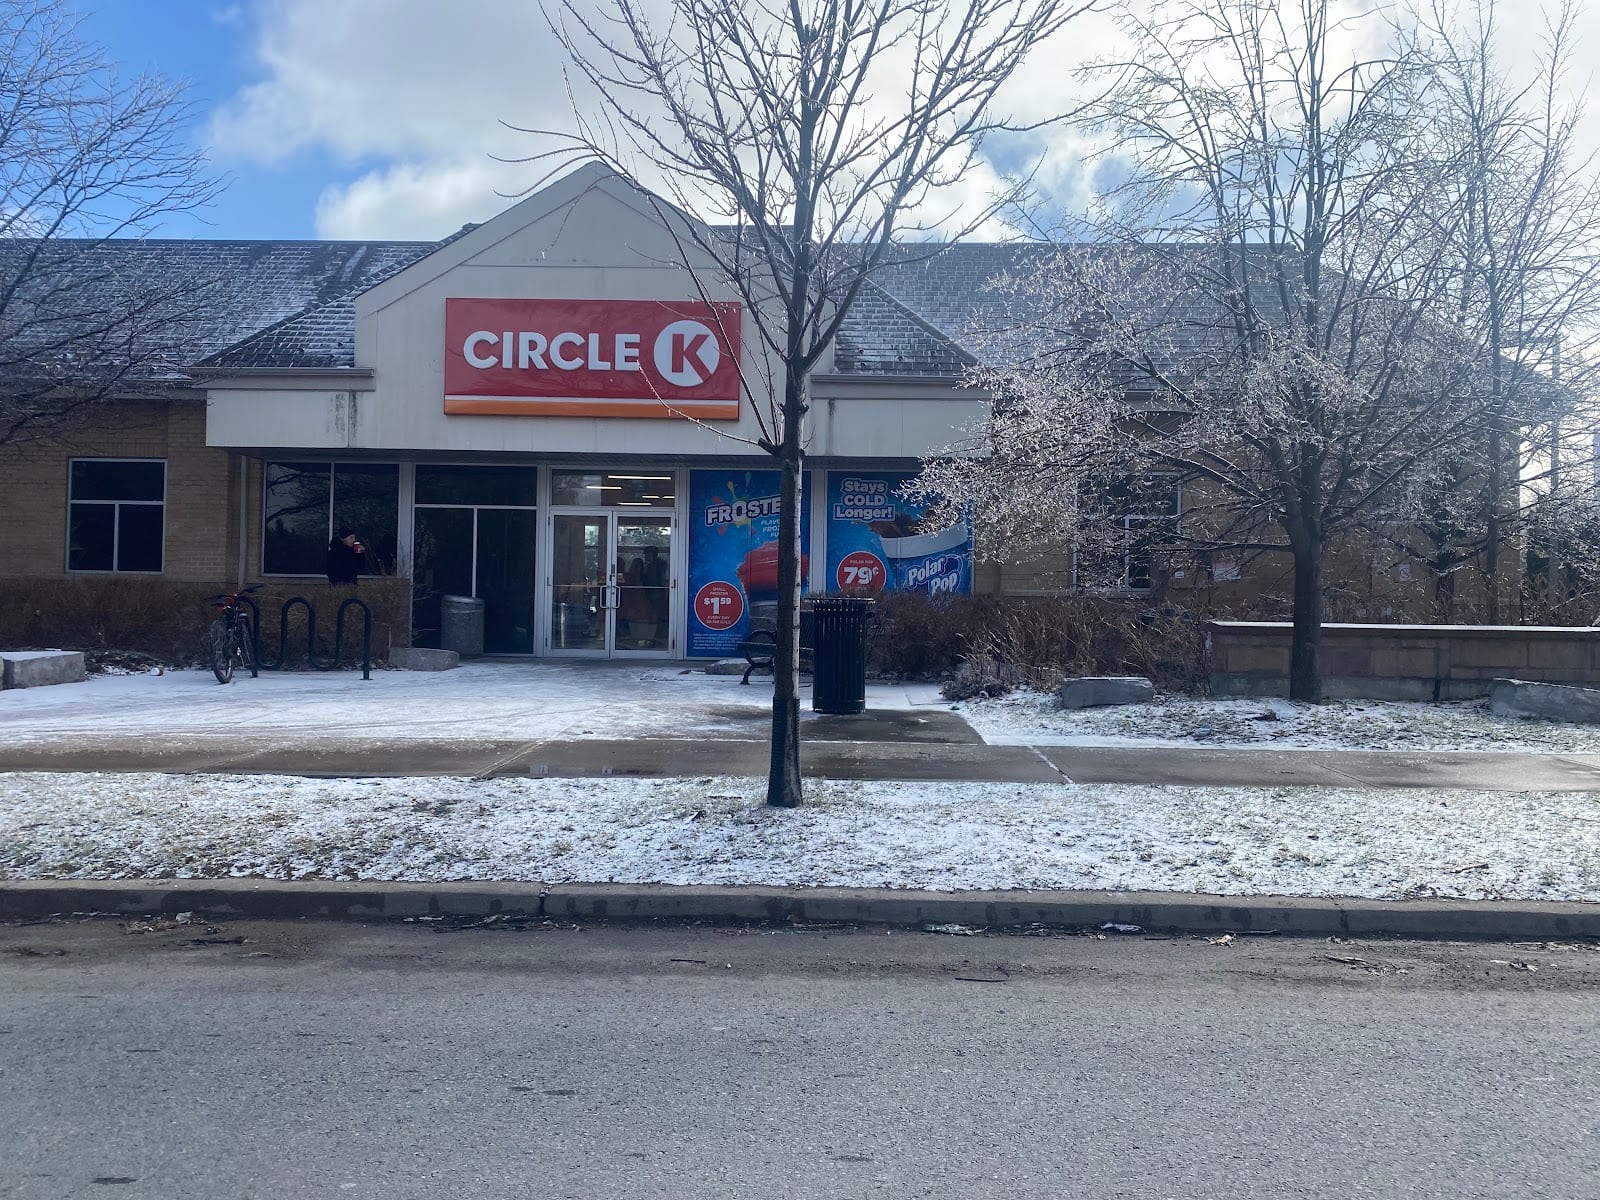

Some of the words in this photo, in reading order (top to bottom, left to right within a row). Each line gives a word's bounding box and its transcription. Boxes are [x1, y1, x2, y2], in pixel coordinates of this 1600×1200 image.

[463, 330, 641, 372] CIRCLE
[669, 331, 716, 386] K
[844, 480, 885, 494] Stays
[843, 494, 885, 506] COLD
[706, 496, 780, 524] FROSTE
[836, 506, 893, 519] Longer!
[762, 525, 780, 533] FRO
[908, 557, 945, 586] Polar
[931, 572, 958, 597] Pop
